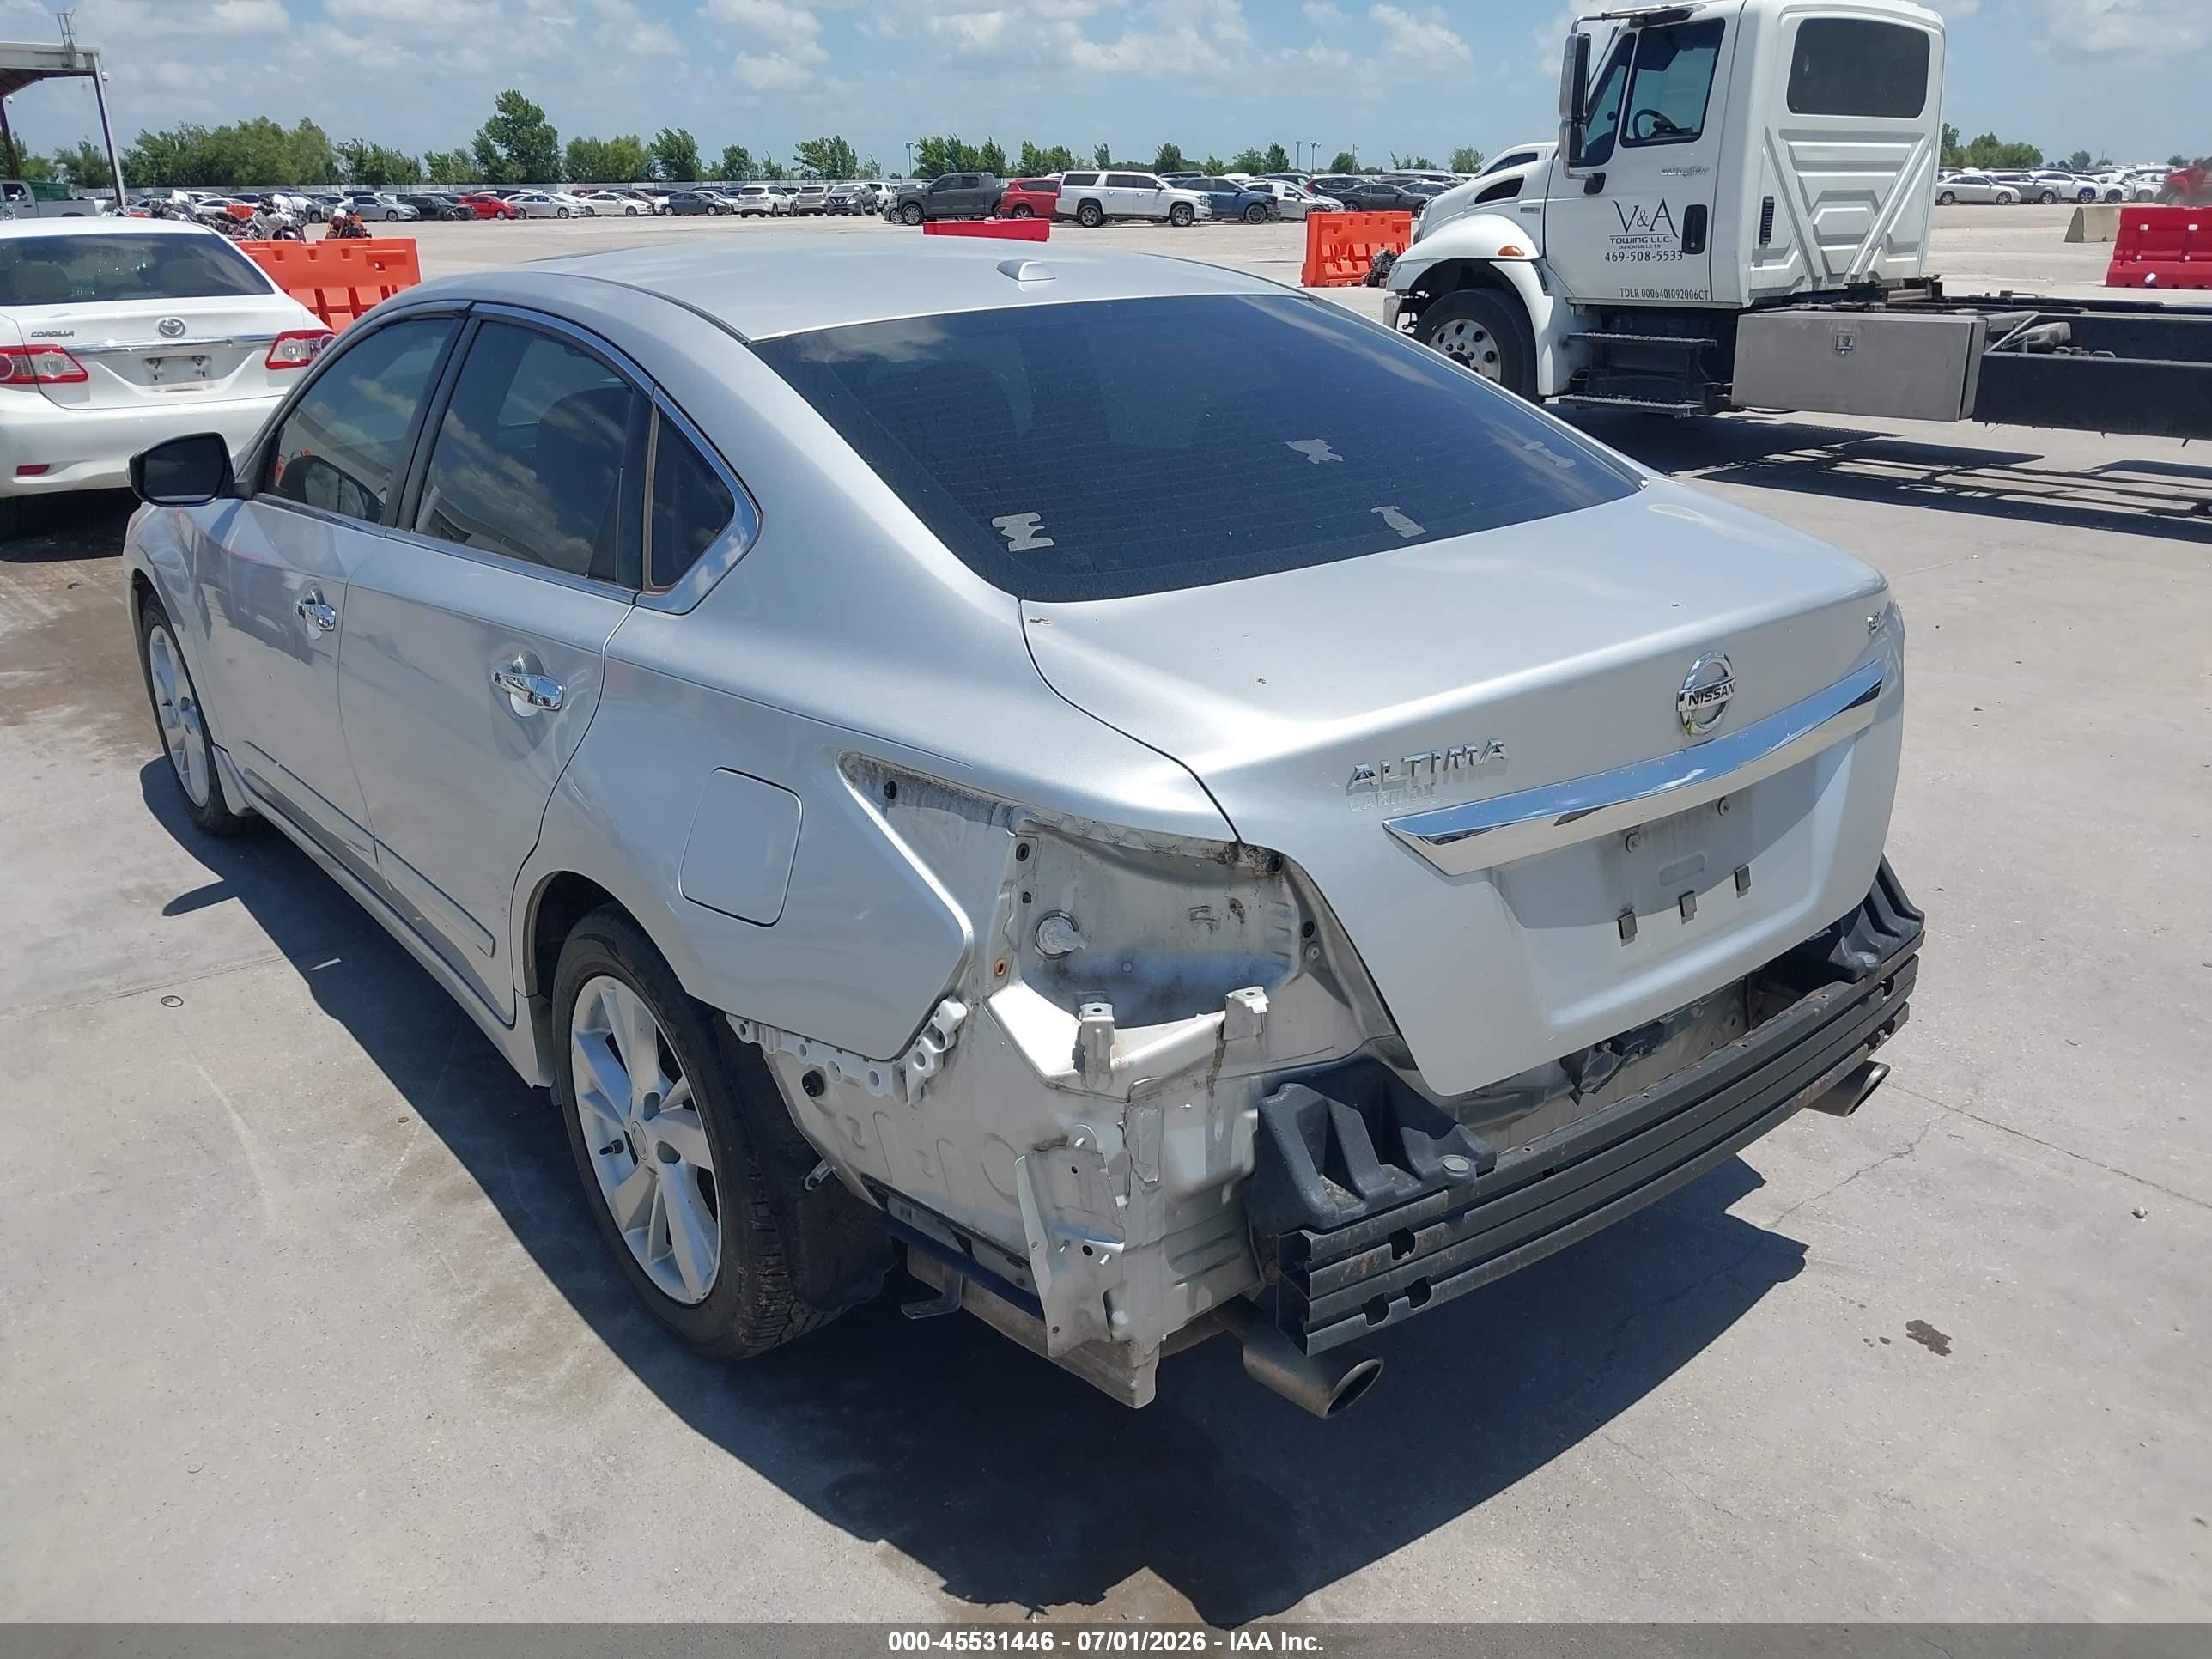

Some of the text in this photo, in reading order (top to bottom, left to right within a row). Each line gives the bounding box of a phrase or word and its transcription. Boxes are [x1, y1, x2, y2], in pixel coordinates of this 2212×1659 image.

[1612, 197, 1680, 239] V&A
[1610, 236, 1649, 245] TOWING
[1604, 250, 1684, 262] 469-508-5533
[1620, 288, 1640, 298] TDLR
[30, 330, 75, 338] COROLLA
[1687, 682, 1735, 707] NISSAN
[1346, 738, 1510, 795] ALTIMA
